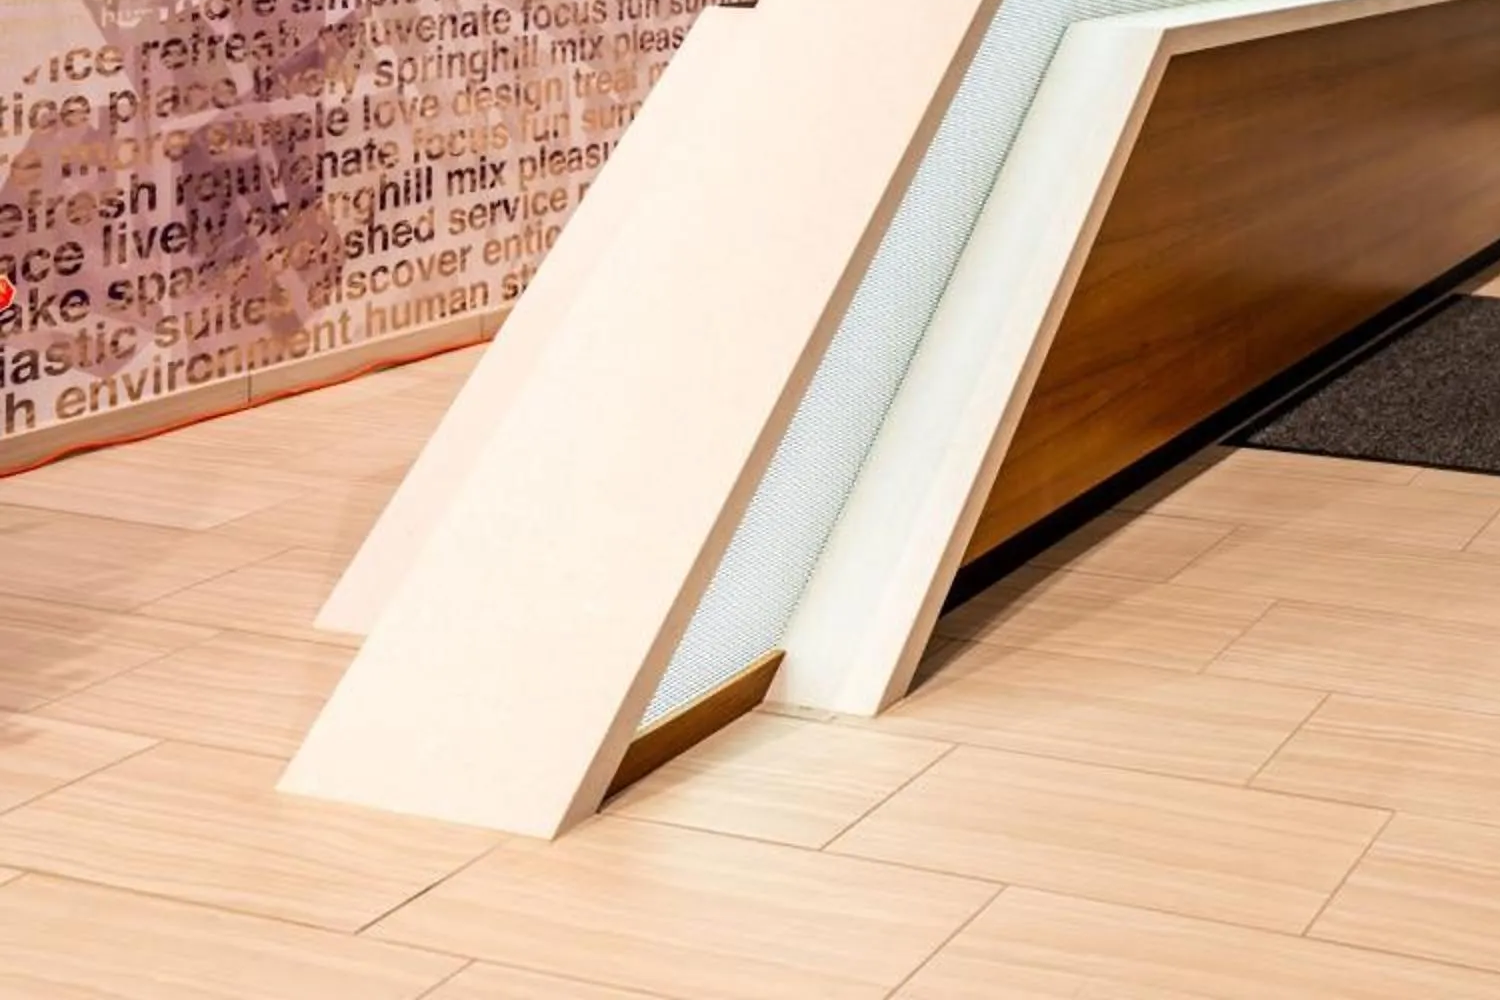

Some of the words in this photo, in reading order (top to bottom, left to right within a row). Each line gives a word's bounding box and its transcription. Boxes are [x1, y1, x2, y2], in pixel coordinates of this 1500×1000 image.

[374, 34, 539, 95] springhill
[551, 29, 605, 65] mix
[362, 93, 439, 131] love
[451, 73, 562, 117] design
[412, 121, 509, 163] focus
[101, 206, 232, 267] lively
[445, 155, 508, 197] mix
[446, 184, 569, 236] service
[152, 287, 293, 350] suites
[305, 244, 473, 312] discover
[55, 308, 353, 423] environment
[364, 279, 489, 338] human
